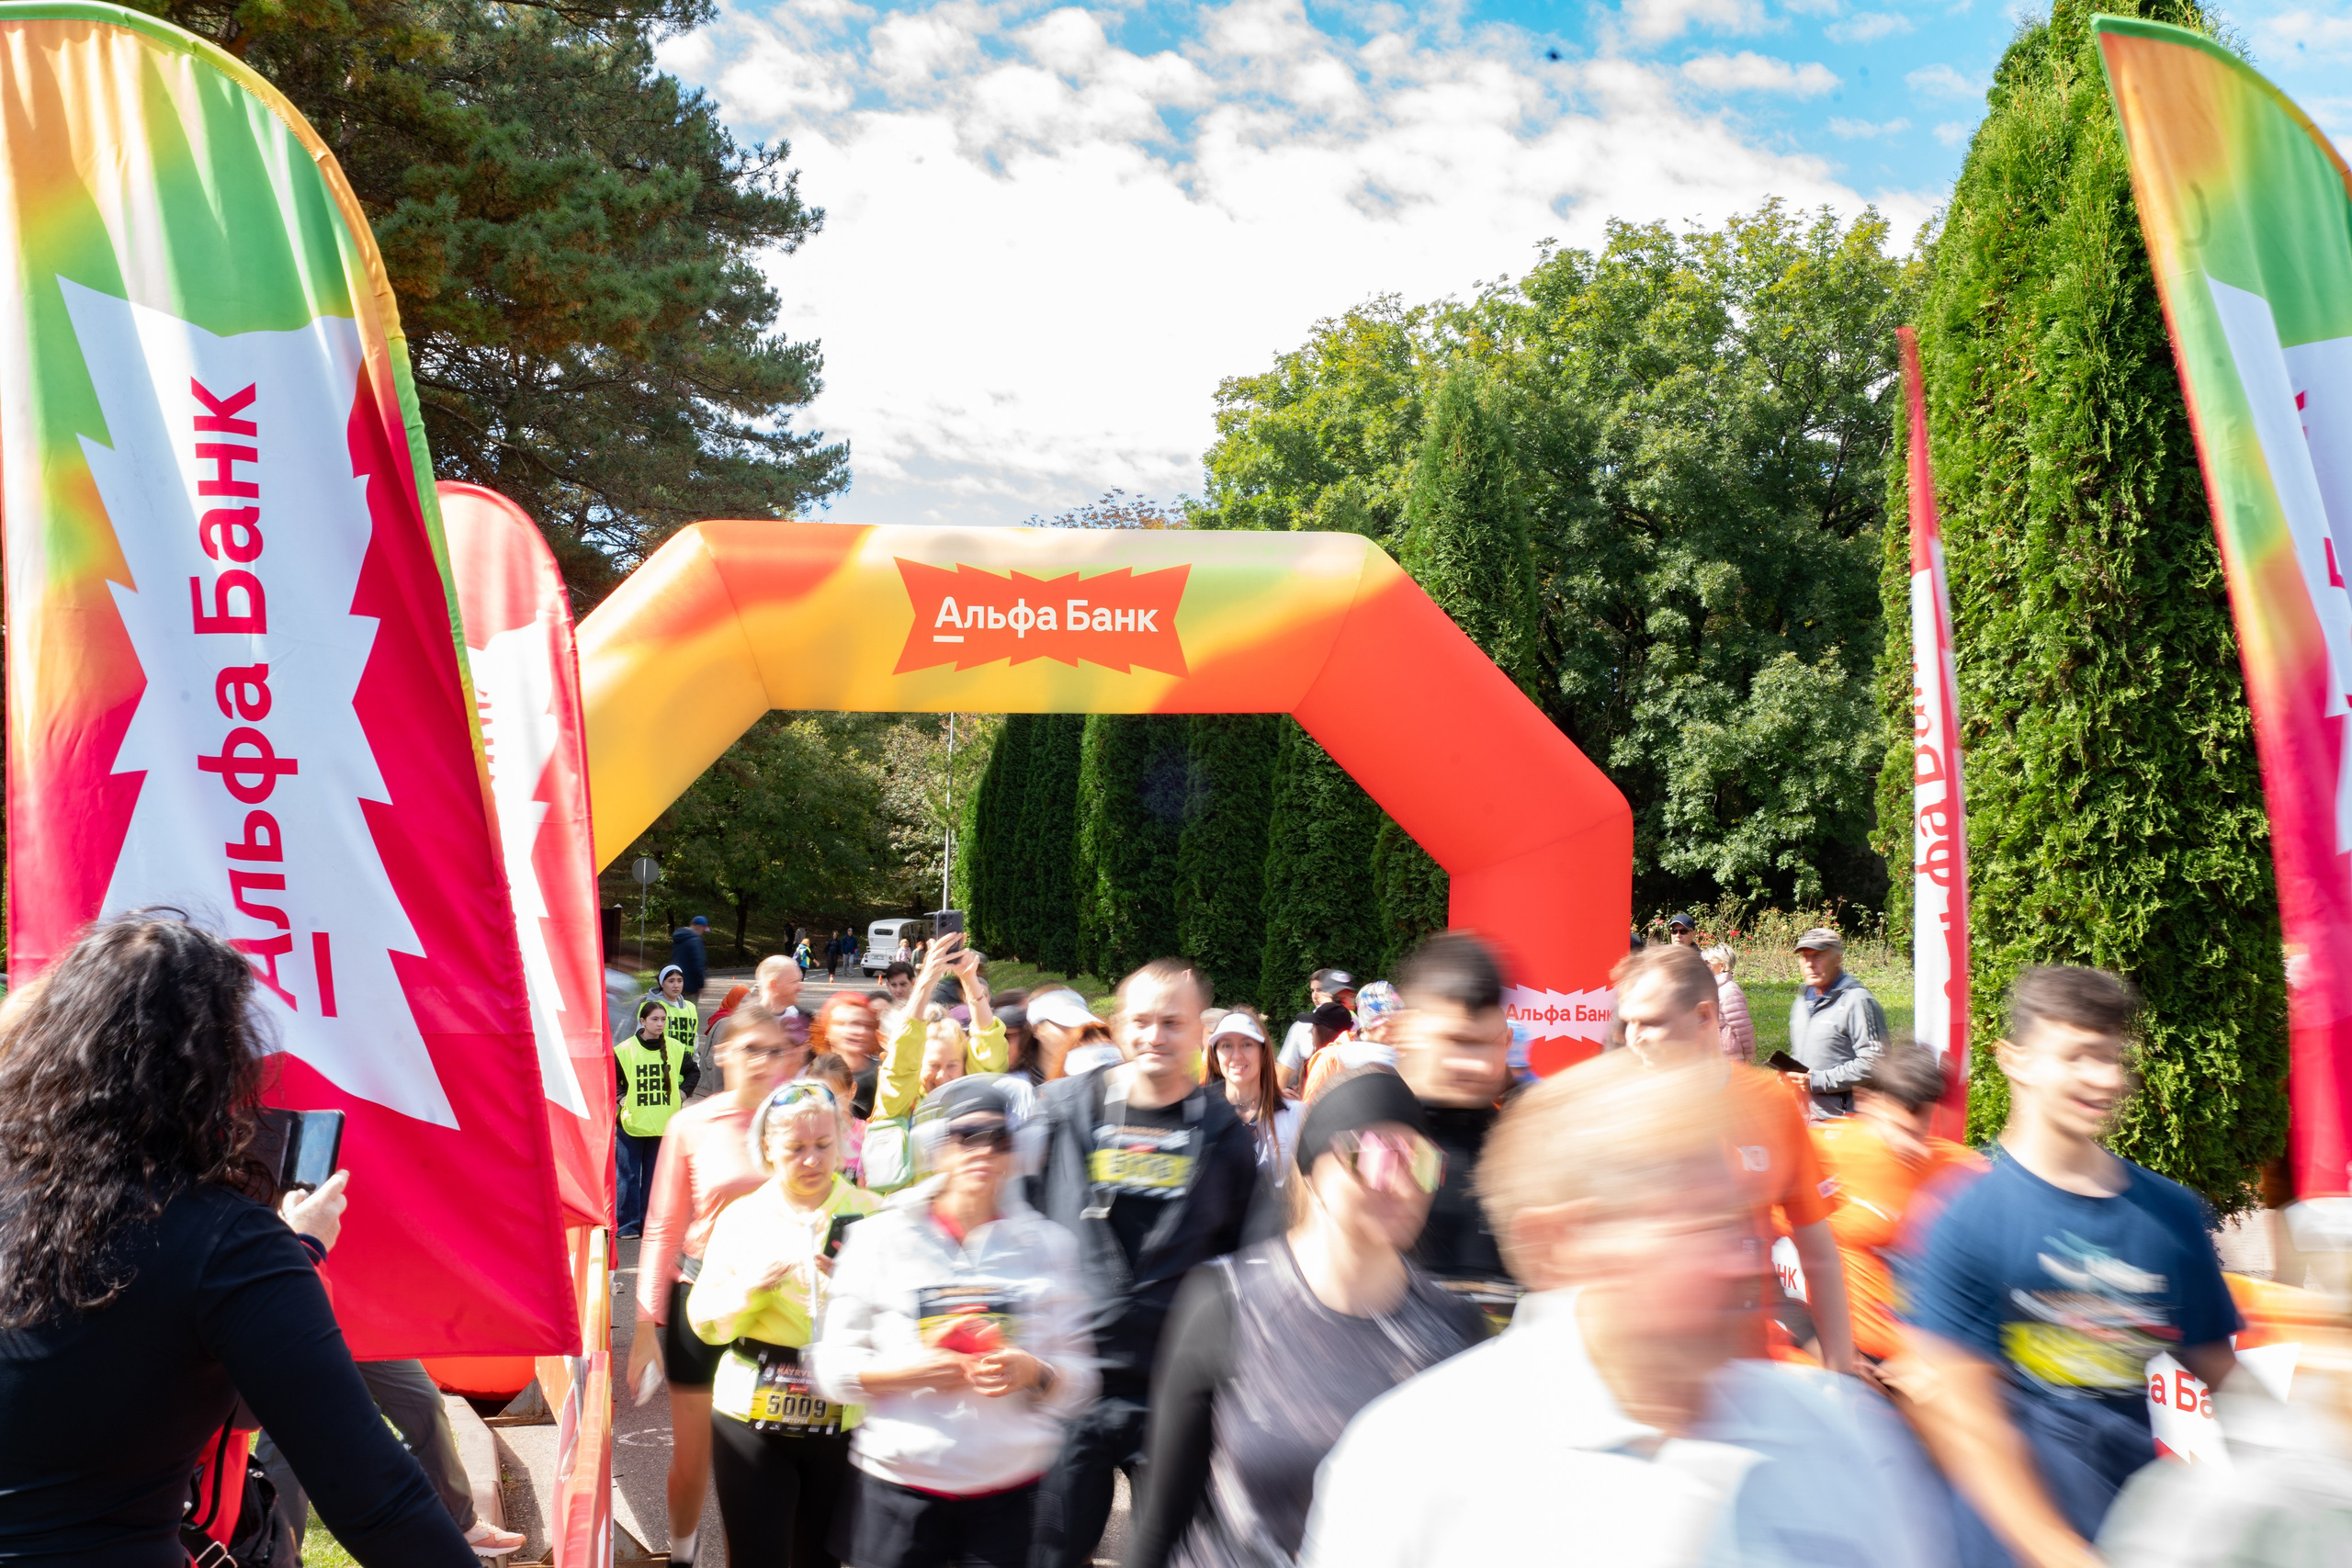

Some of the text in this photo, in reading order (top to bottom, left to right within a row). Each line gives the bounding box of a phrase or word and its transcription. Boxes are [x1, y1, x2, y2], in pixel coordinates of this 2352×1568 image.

[933, 596, 1159, 642] Альфа Банк
[188, 375, 301, 1013] Альфа Банк
[1506, 1003, 1571, 1026] Альфа
[636, 1077, 671, 1092] KA
[637, 1092, 671, 1107] RUN
[765, 1394, 827, 1419] 5009
[2175, 1369, 2219, 1421] Ба
